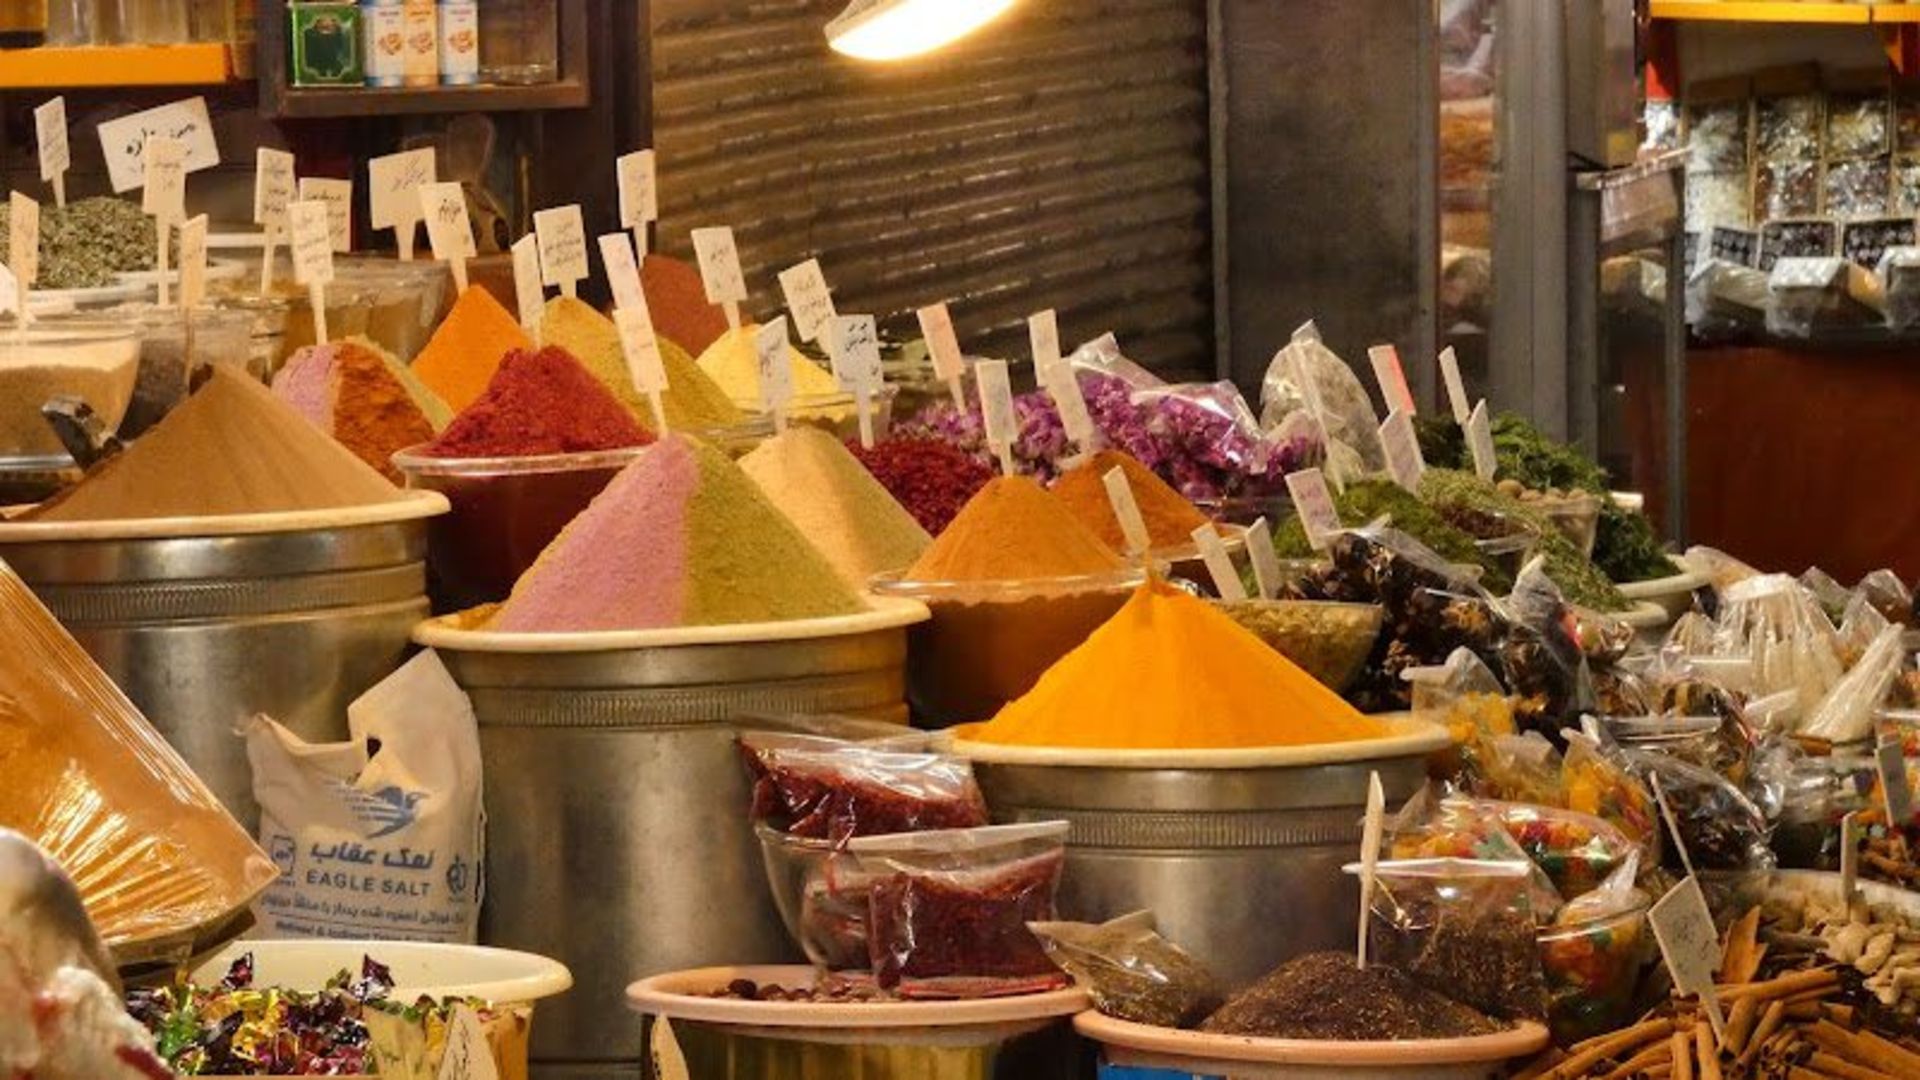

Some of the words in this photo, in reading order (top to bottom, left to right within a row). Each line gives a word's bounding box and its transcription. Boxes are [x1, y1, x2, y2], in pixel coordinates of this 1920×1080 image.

[310, 841, 378, 863] عقاب
[383, 847, 435, 869] نمک
[306, 869, 375, 892] EAGLE
[381, 881, 432, 897] SALT
